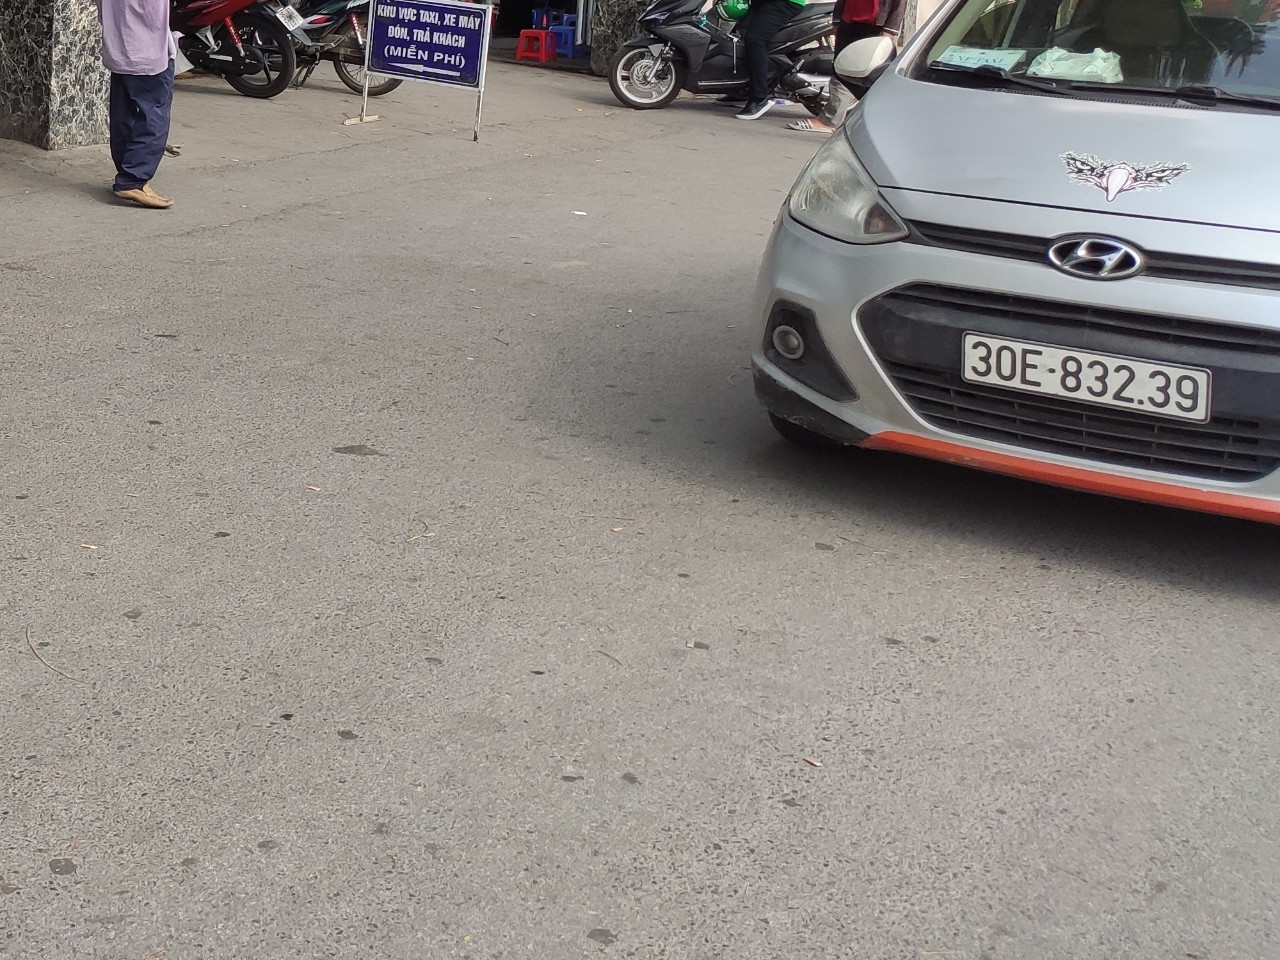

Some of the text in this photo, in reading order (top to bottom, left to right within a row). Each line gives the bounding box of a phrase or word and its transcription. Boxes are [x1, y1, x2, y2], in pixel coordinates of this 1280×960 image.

[377, 4, 397, 18] KHU
[398, 6, 418, 23] VỰC
[443, 13, 457, 26] XE
[458, 14, 481, 30] MÁY
[412, 26, 431, 43] TRẢ
[432, 31, 466, 48] KHÁCH
[970, 340, 1200, 413] 30E-832.39
